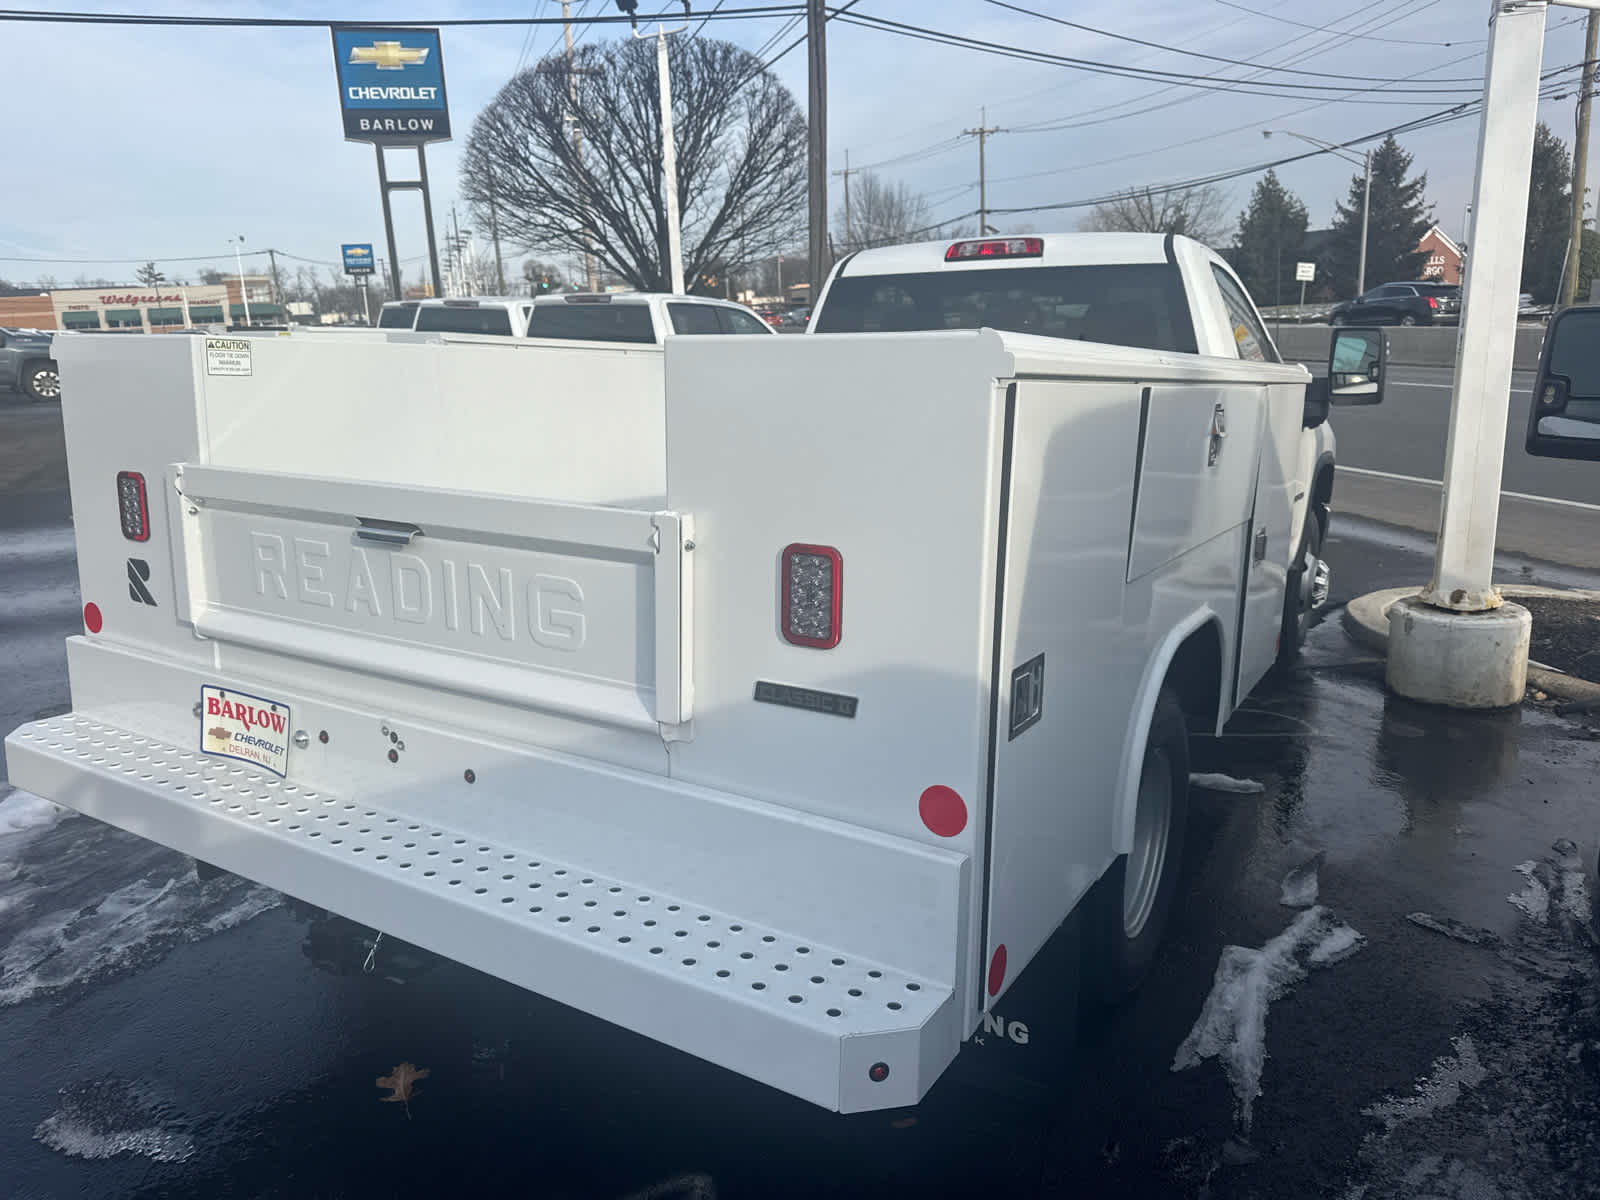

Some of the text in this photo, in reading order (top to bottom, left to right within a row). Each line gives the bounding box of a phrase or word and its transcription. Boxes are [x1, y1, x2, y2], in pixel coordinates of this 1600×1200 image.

[348, 87, 437, 99] CHEVROLET
[359, 118, 434, 130] BARLOW
[98, 294, 182, 307] Walgreens
[215, 341, 249, 350] CAUTION
[250, 530, 588, 651] READING
[207, 696, 286, 735] BARLOW
[234, 732, 285, 756] CHEVROLET
